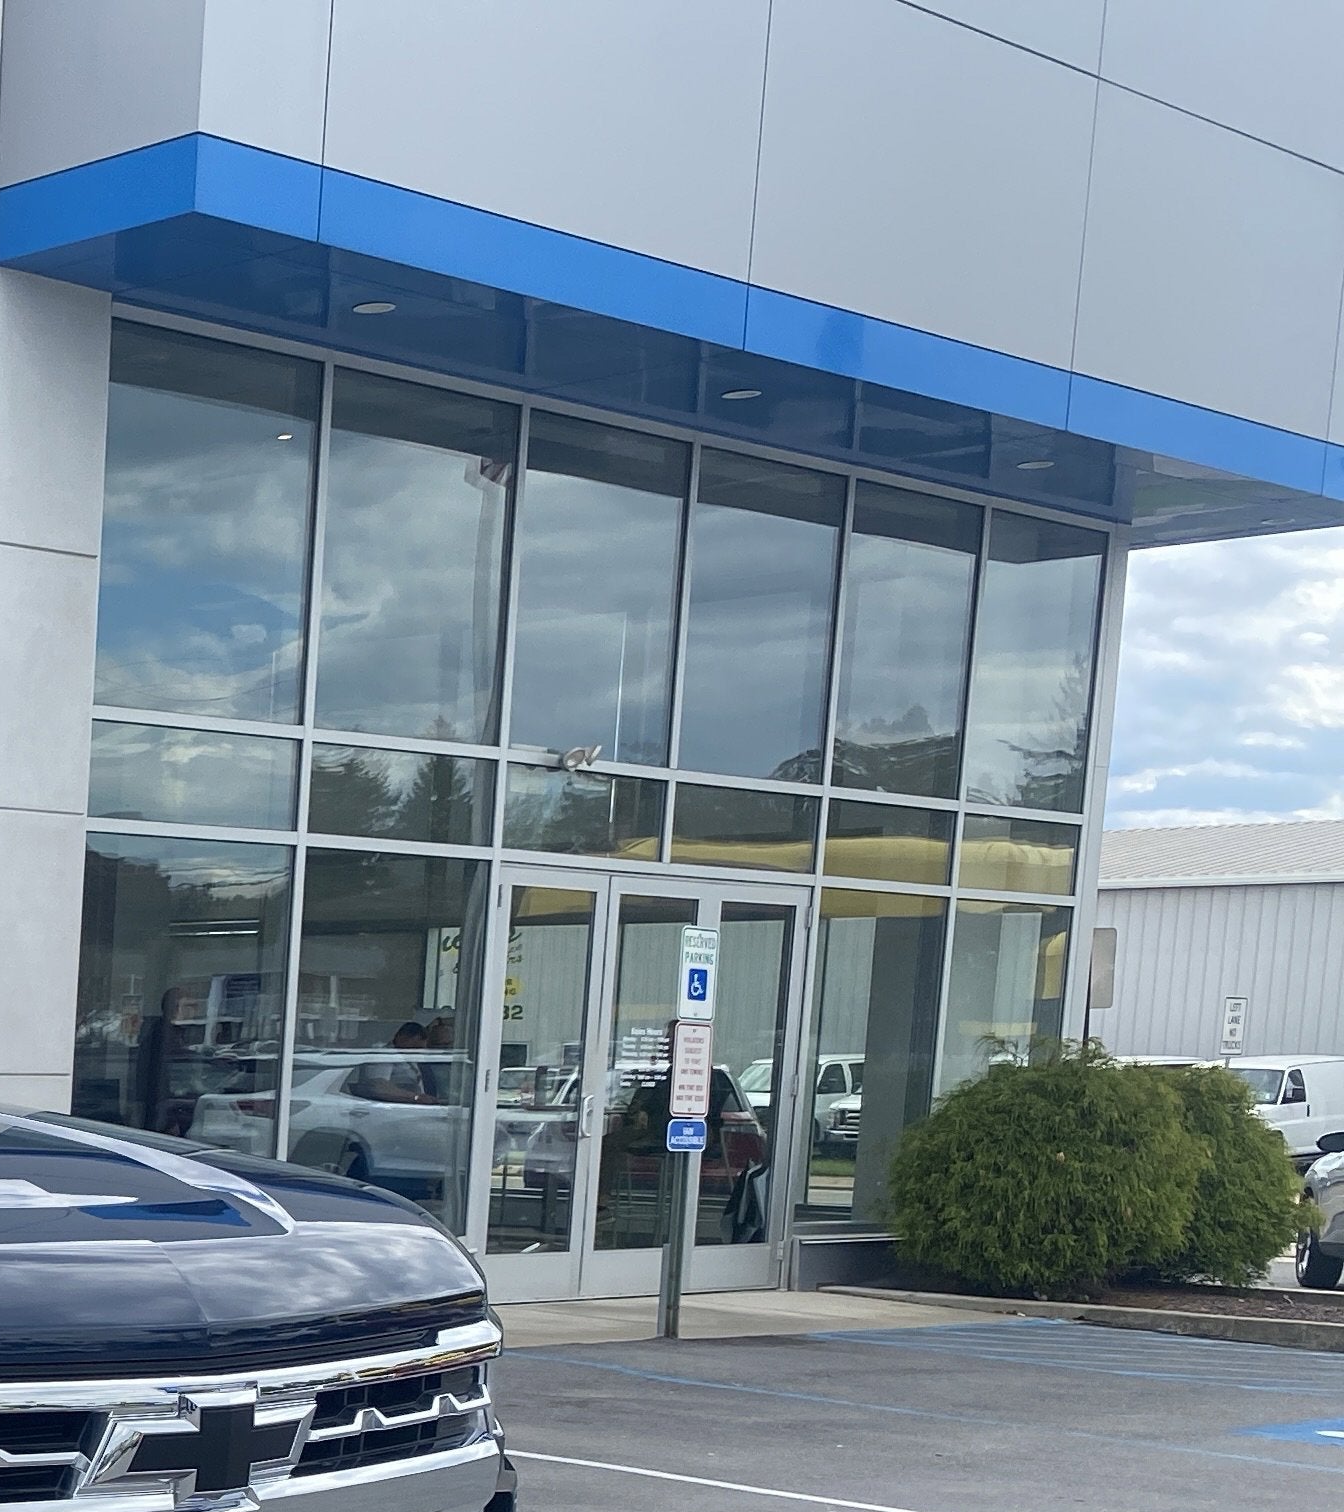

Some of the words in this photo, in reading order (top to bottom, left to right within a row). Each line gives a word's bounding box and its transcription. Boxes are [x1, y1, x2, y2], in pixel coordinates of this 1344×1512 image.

[685, 935, 715, 949] RESERVED
[685, 951, 714, 965] PARKING
[1230, 1003, 1242, 1012] LEFT
[1227, 1015, 1241, 1024] LANE
